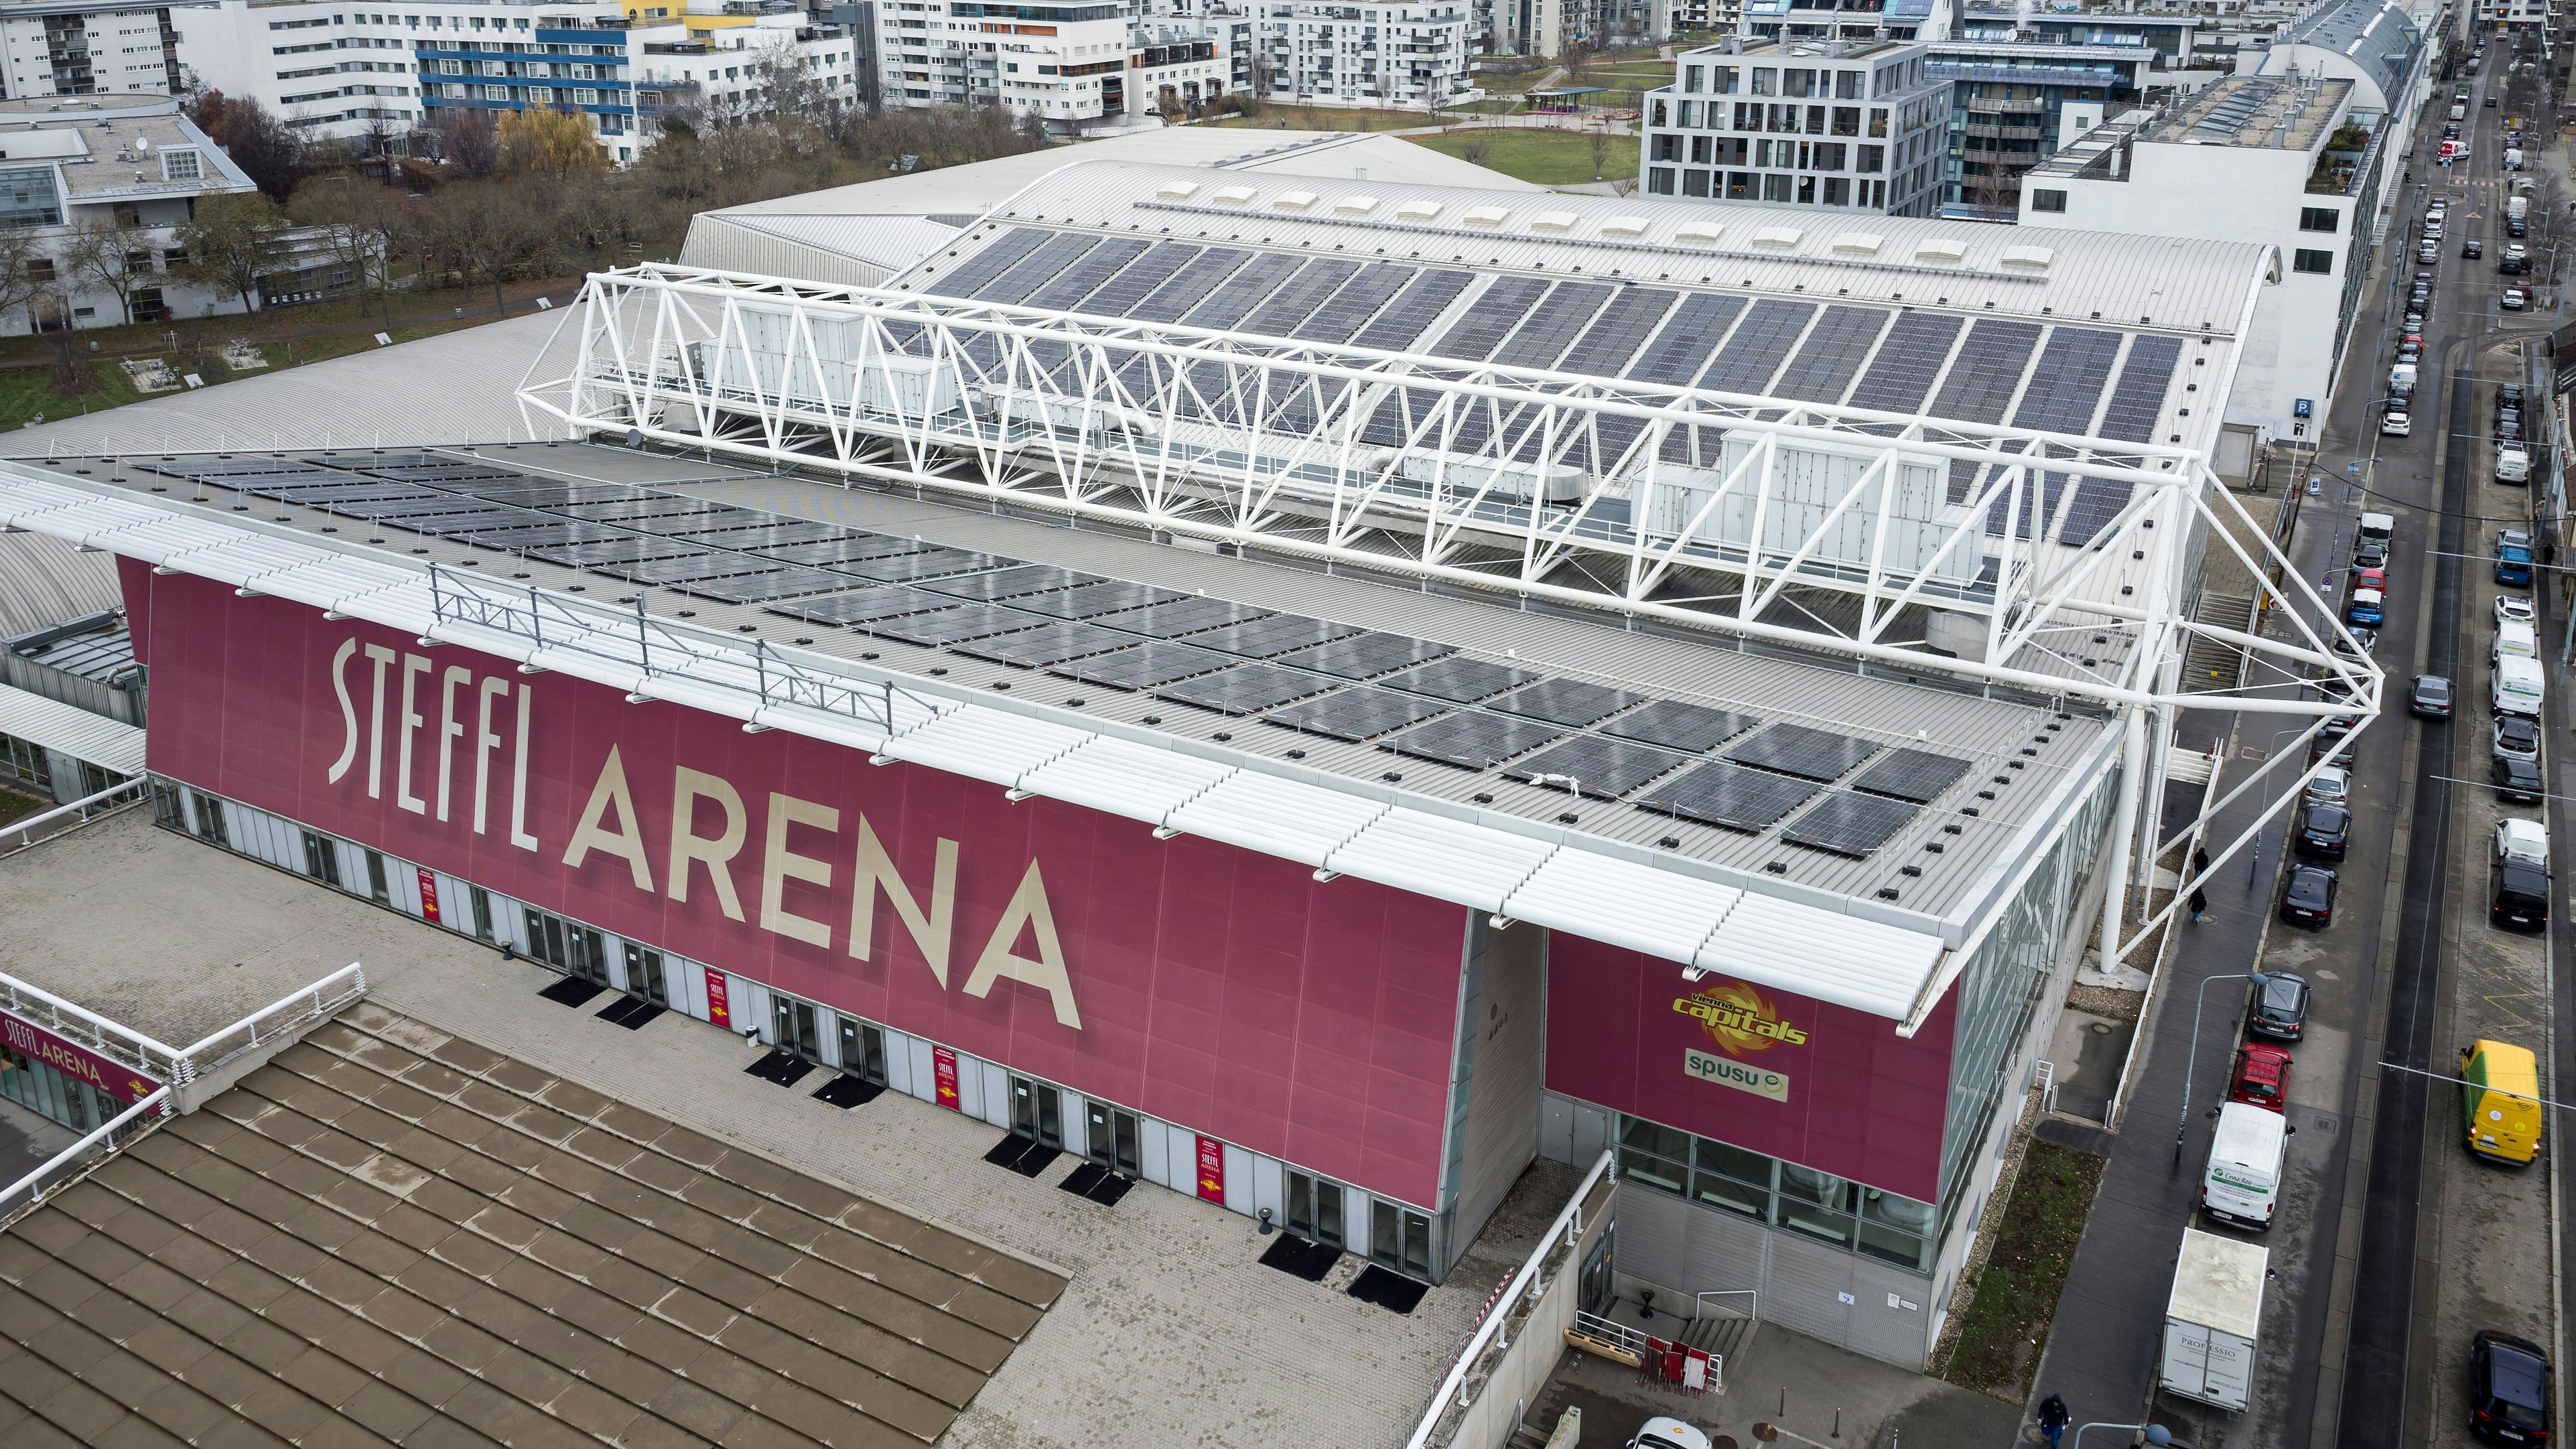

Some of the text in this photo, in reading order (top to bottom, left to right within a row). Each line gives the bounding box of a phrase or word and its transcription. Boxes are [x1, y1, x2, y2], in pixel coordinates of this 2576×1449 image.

[2298, 403, 2307, 412] P
[328, 636, 1083, 1030] STEFFL ARENA
[1692, 993, 1734, 1010] vienna
[1672, 997, 1808, 1045] capitals
[5, 1019, 103, 1085] STEFFL ARENA
[938, 1062, 953, 1076] STEFFL
[1689, 1056, 1759, 1086] spusu
[1201, 1153, 1219, 1168] STEFFL
[1201, 1162, 1221, 1174] ARENA
